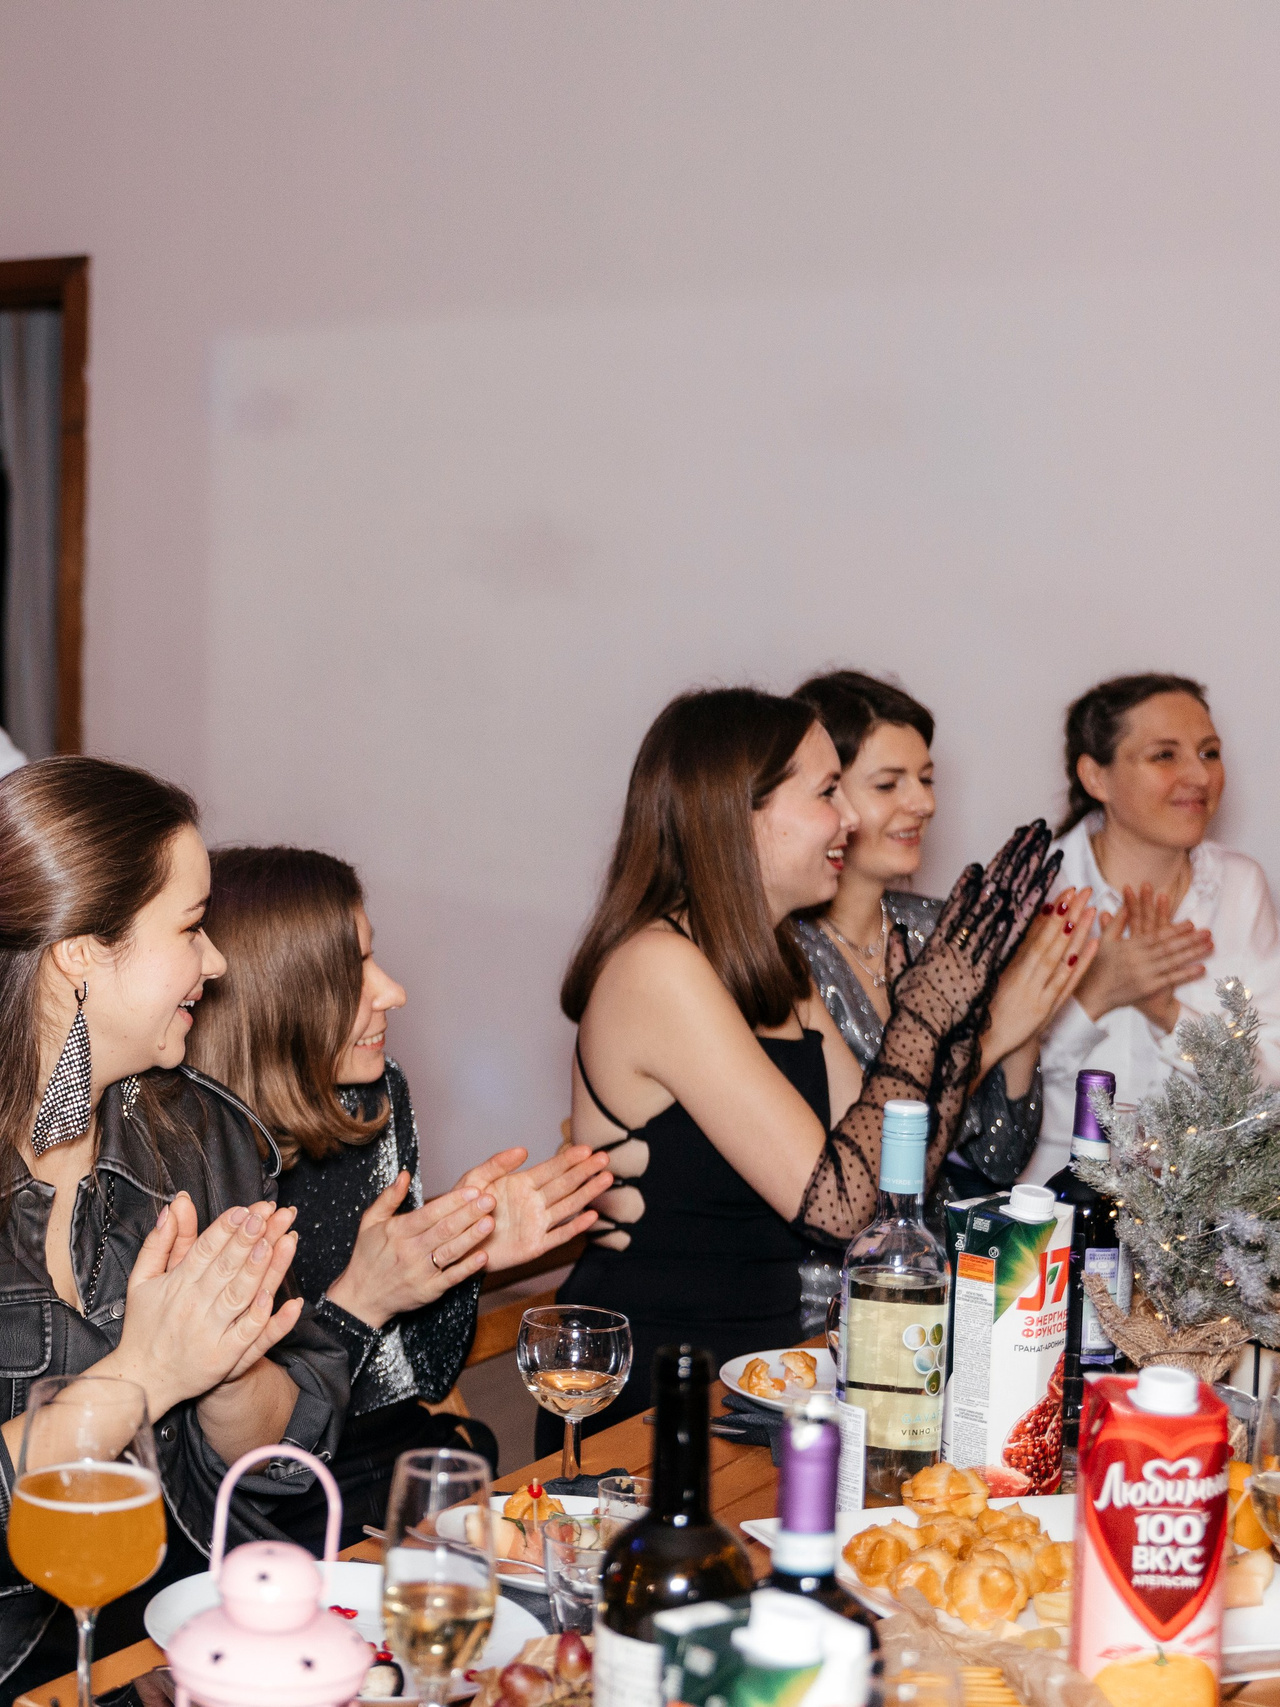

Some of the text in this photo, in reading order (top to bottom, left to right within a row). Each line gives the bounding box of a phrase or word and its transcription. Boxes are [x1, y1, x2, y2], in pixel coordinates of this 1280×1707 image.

[1016, 1246, 1071, 1312] J7
[1023, 1308, 1069, 1327] ЭНЕРГИЯ
[1013, 1338, 1065, 1353] ГРАНАТ-АРОНИЯ
[901, 1427, 931, 1436] VINHO
[1093, 1457, 1228, 1511] Любимы
[1132, 1545, 1205, 1574] ВКУС
